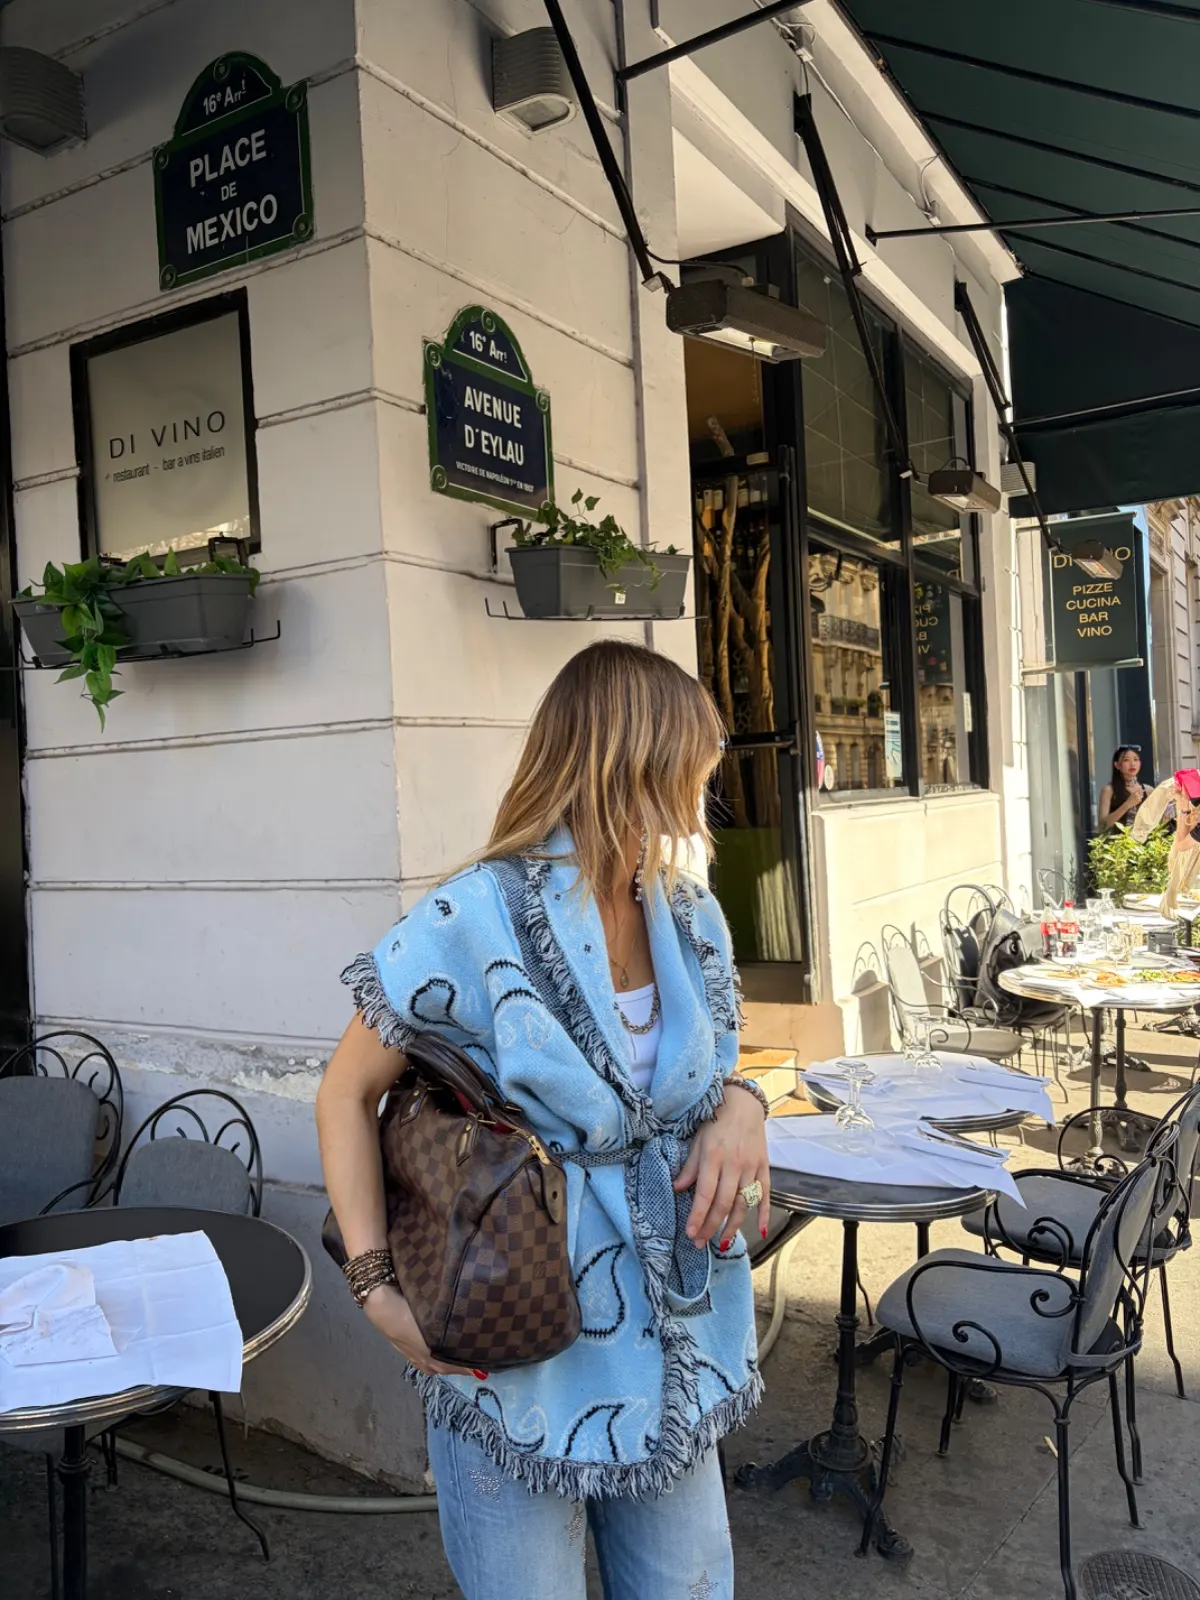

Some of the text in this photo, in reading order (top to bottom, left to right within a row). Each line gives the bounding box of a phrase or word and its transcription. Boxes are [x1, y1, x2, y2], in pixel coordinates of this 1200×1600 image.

[189, 129, 267, 188] PLACE
[221, 181, 238, 201] DE
[186, 193, 278, 255] MEXICO
[464, 386, 522, 429] AVENUE
[109, 410, 226, 459] DI VINO
[464, 424, 525, 466] D'EYLAU
[112, 463, 150, 483] restaurant
[162, 458, 176, 471] bar
[185, 451, 200, 466] vins
[202, 445, 225, 462] italien
[455, 460, 478, 475] VICTOIRE
[479, 467, 486, 478] DE
[1053, 554, 1073, 569] DI
[1072, 582, 1113, 596] PIZZE
[1066, 596, 1121, 611] CUCINA
[1079, 611, 1108, 624] BAR
[1077, 625, 1112, 638] VINO
